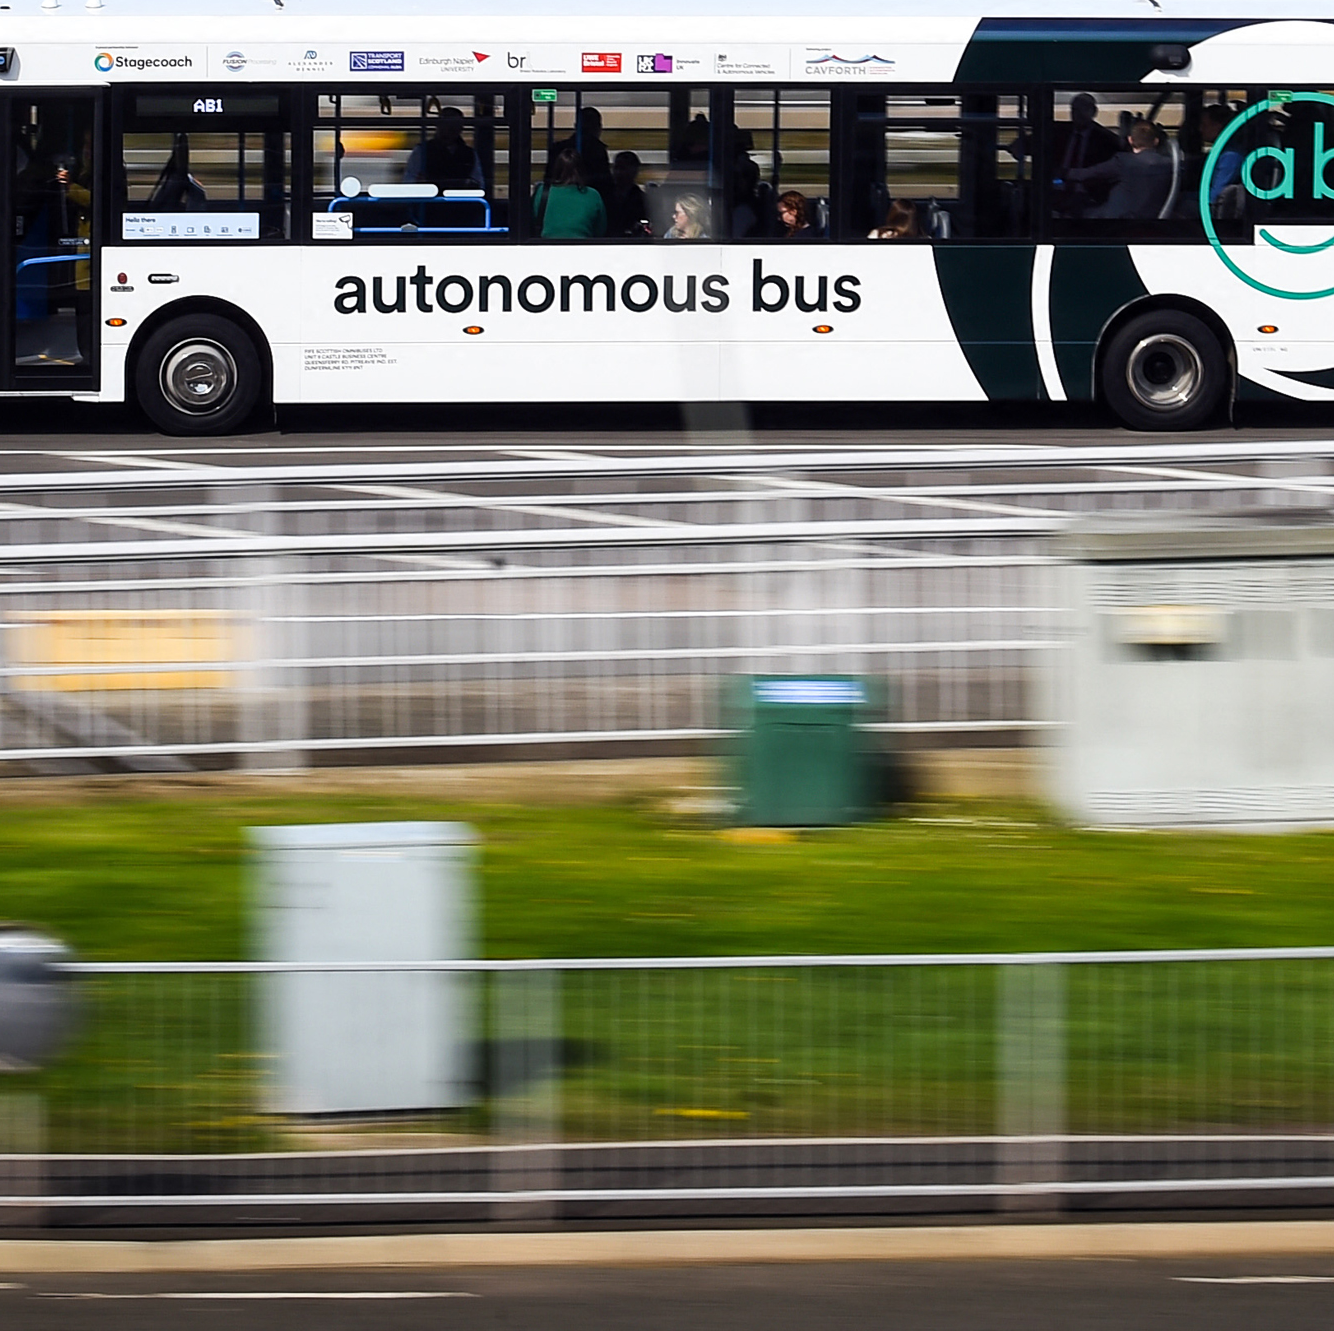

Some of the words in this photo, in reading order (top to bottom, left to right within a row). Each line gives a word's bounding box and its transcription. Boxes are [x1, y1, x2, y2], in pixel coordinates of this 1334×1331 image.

[115, 55, 192, 70] Stagecoach
[419, 57, 452, 65] Edinburgh
[453, 57, 474, 65] Napier
[805, 66, 867, 75] CAVFORTH
[193, 98, 224, 113] AB1
[333, 265, 730, 314] autonomous
[751, 258, 862, 314] bus
